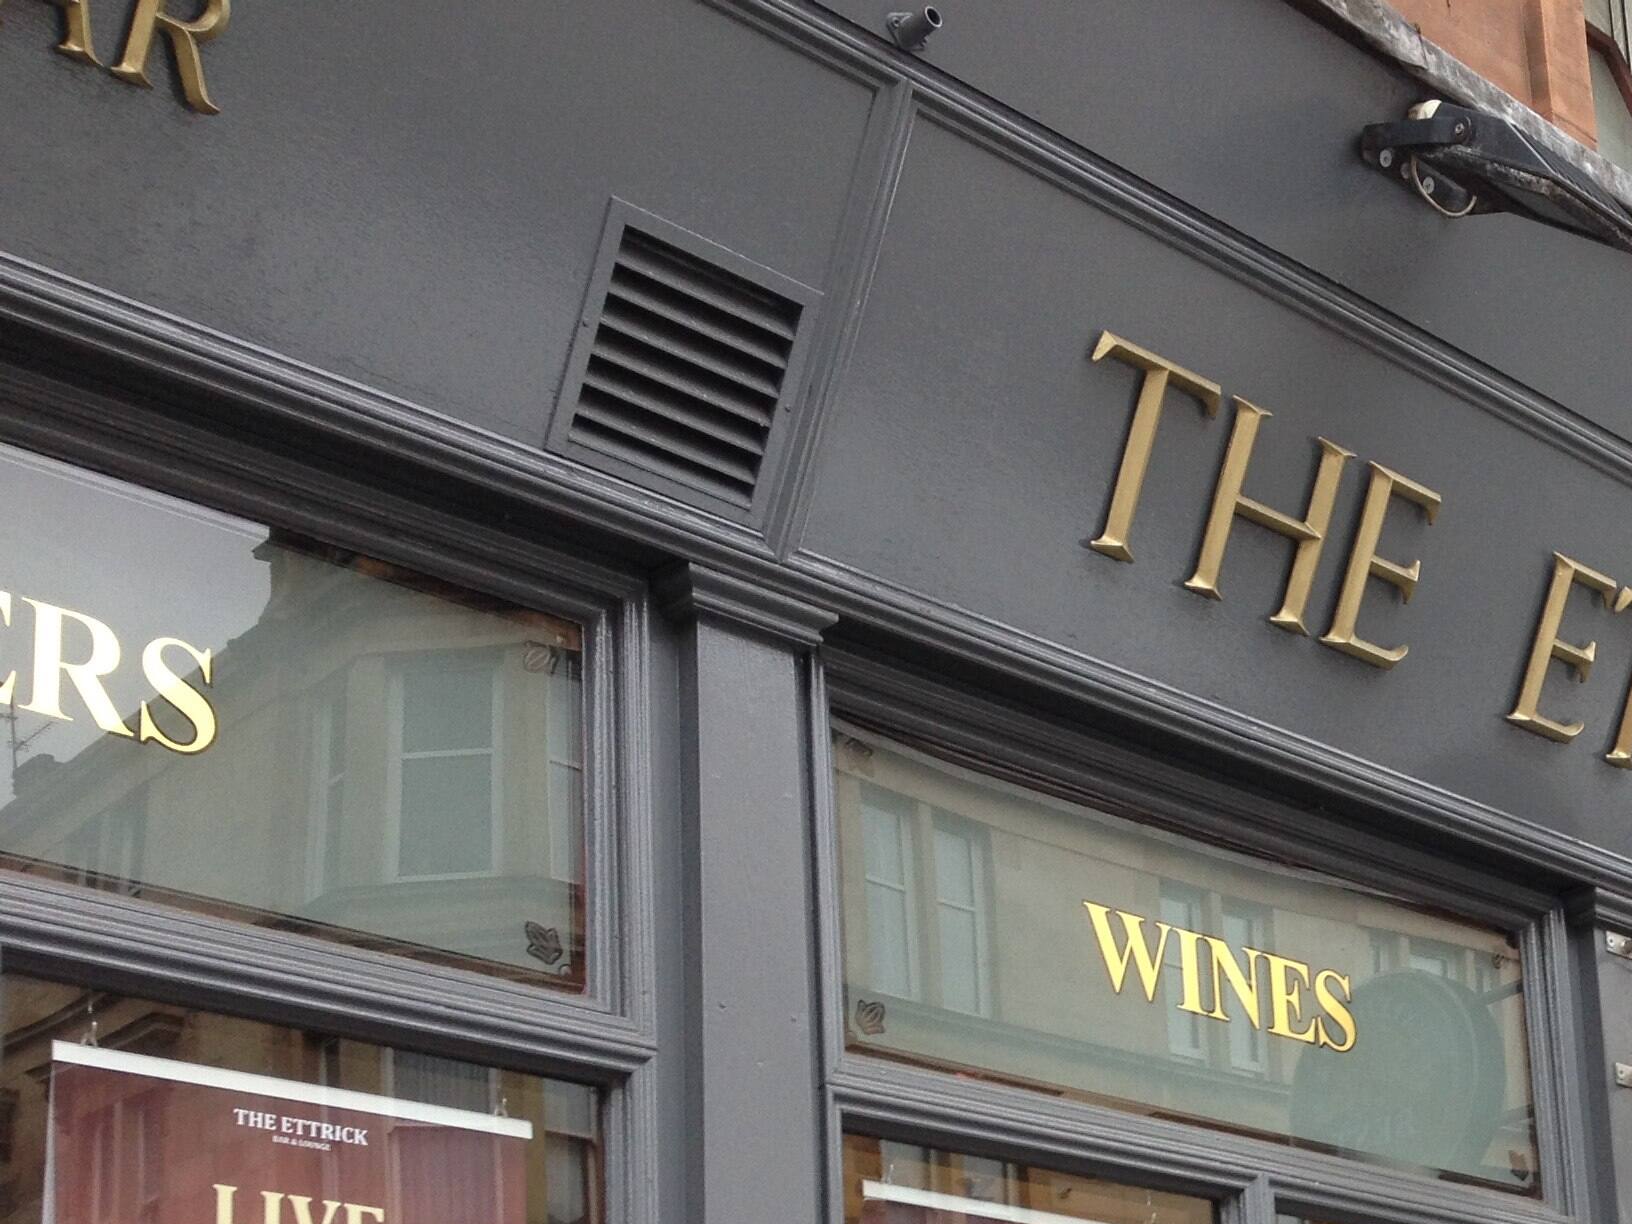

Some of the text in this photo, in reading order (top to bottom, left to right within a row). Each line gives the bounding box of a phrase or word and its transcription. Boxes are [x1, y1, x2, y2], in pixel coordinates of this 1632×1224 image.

[1090, 330, 1441, 669] THE
[1083, 900, 1357, 1053] WINES
[233, 1108, 369, 1146] THE ETTRICK
